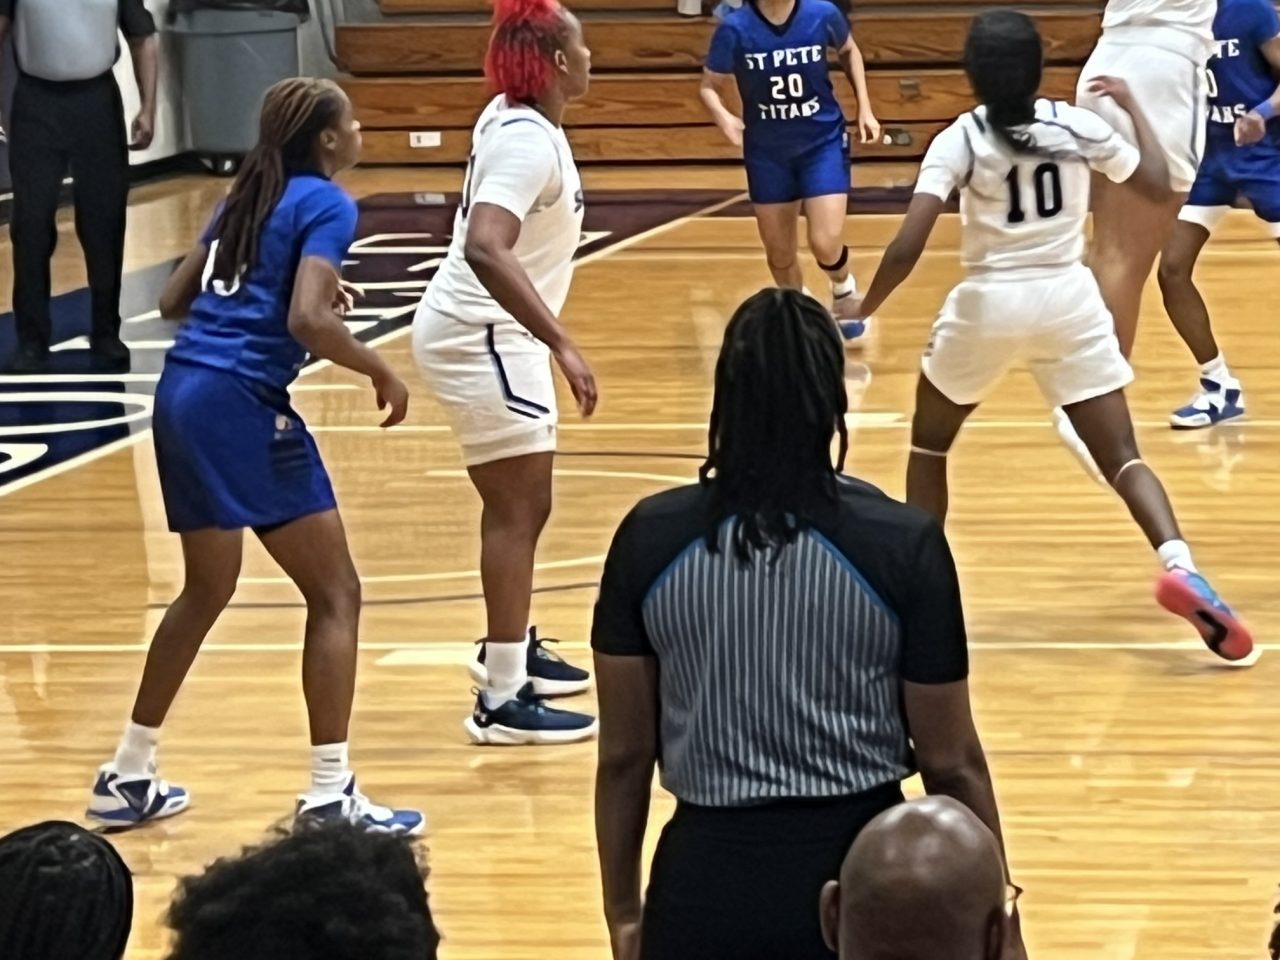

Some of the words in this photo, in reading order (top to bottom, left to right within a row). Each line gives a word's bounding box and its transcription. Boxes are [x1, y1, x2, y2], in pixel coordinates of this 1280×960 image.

[744, 52, 768, 70] ST
[773, 44, 822, 68] PETE
[769, 73, 804, 100] 20
[1004, 162, 1063, 223] 10
